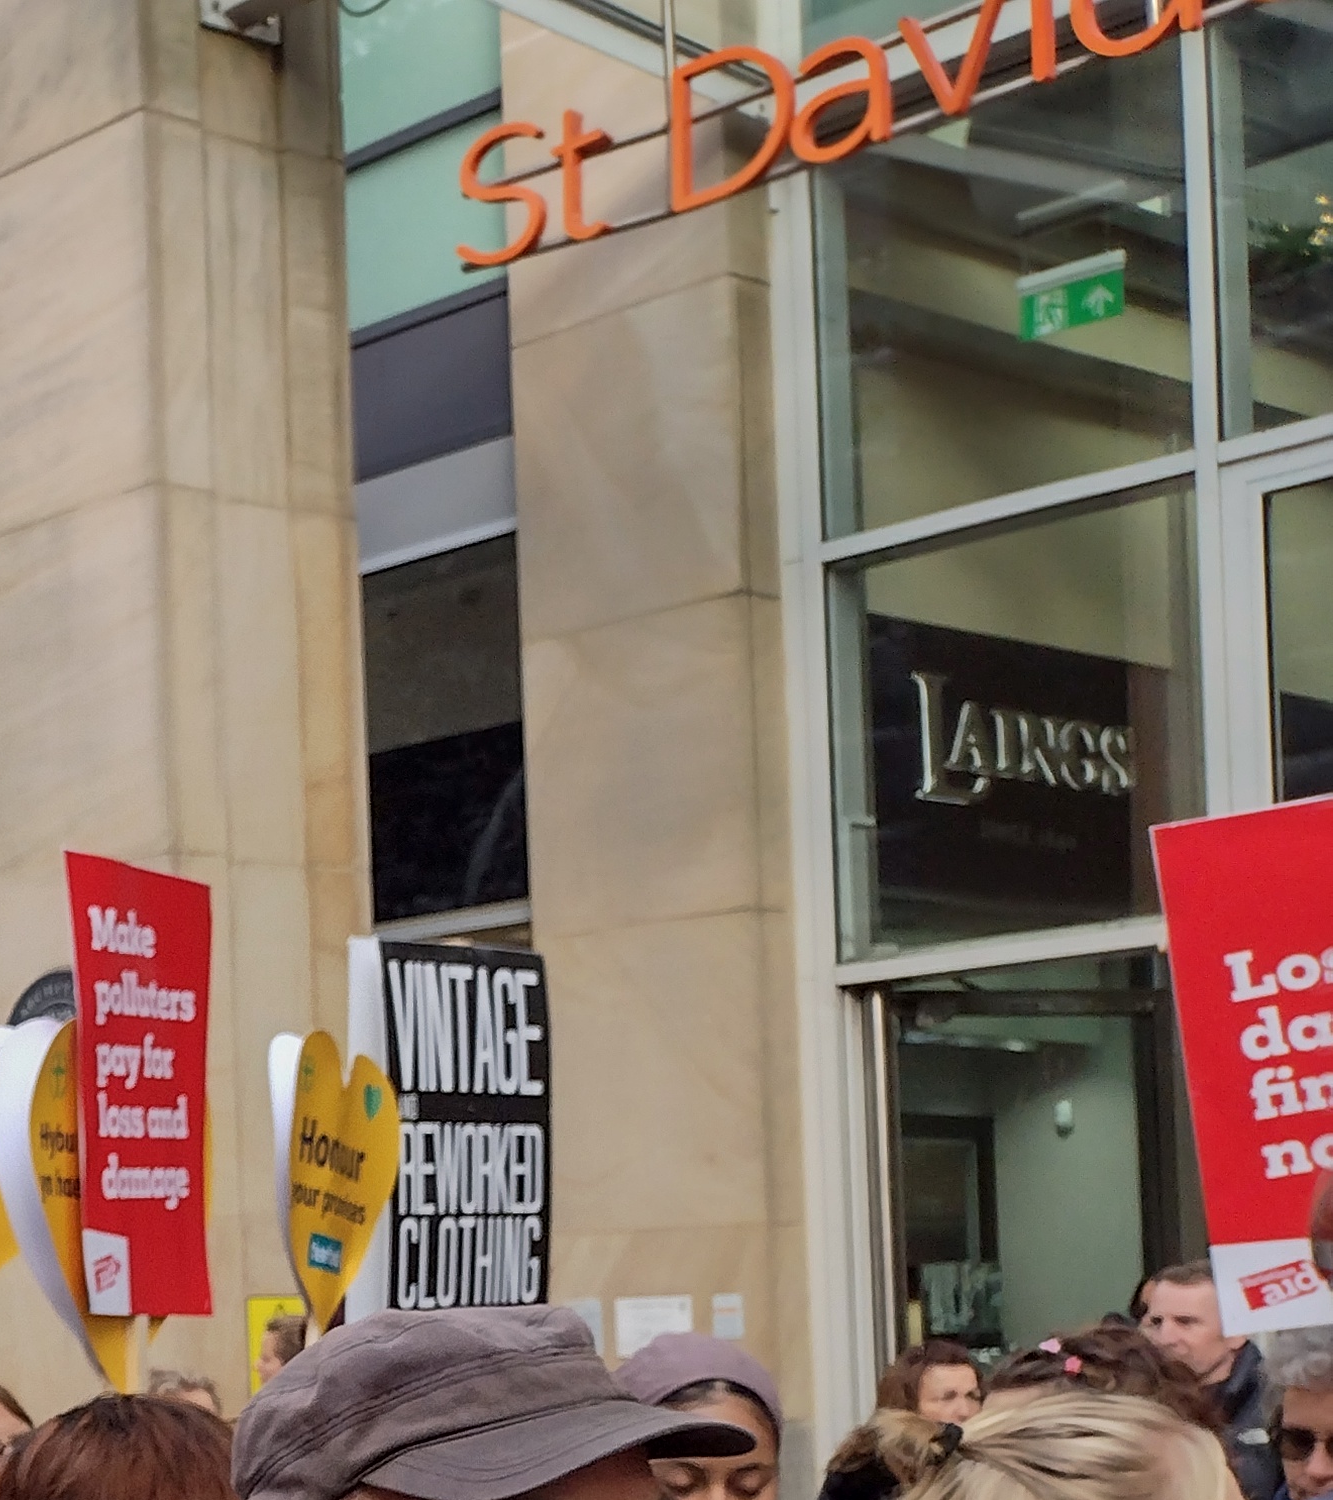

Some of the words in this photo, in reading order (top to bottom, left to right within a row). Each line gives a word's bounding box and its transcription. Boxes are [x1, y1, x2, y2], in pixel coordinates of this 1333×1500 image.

[456, 108, 614, 267] St
[909, 669, 1134, 806] LAINGS
[87, 904, 157, 959] Make
[94, 969, 196, 1026] polluters
[387, 958, 544, 1096] VINTAGE
[96, 1043, 141, 1089] pay
[142, 1032, 175, 1080] for
[98, 1091, 145, 1139] loss
[147, 1094, 189, 1139] and
[101, 1153, 190, 1211] damage
[399, 1121, 545, 1217] REWORKED
[398, 1216, 542, 1310] CLOTHING
